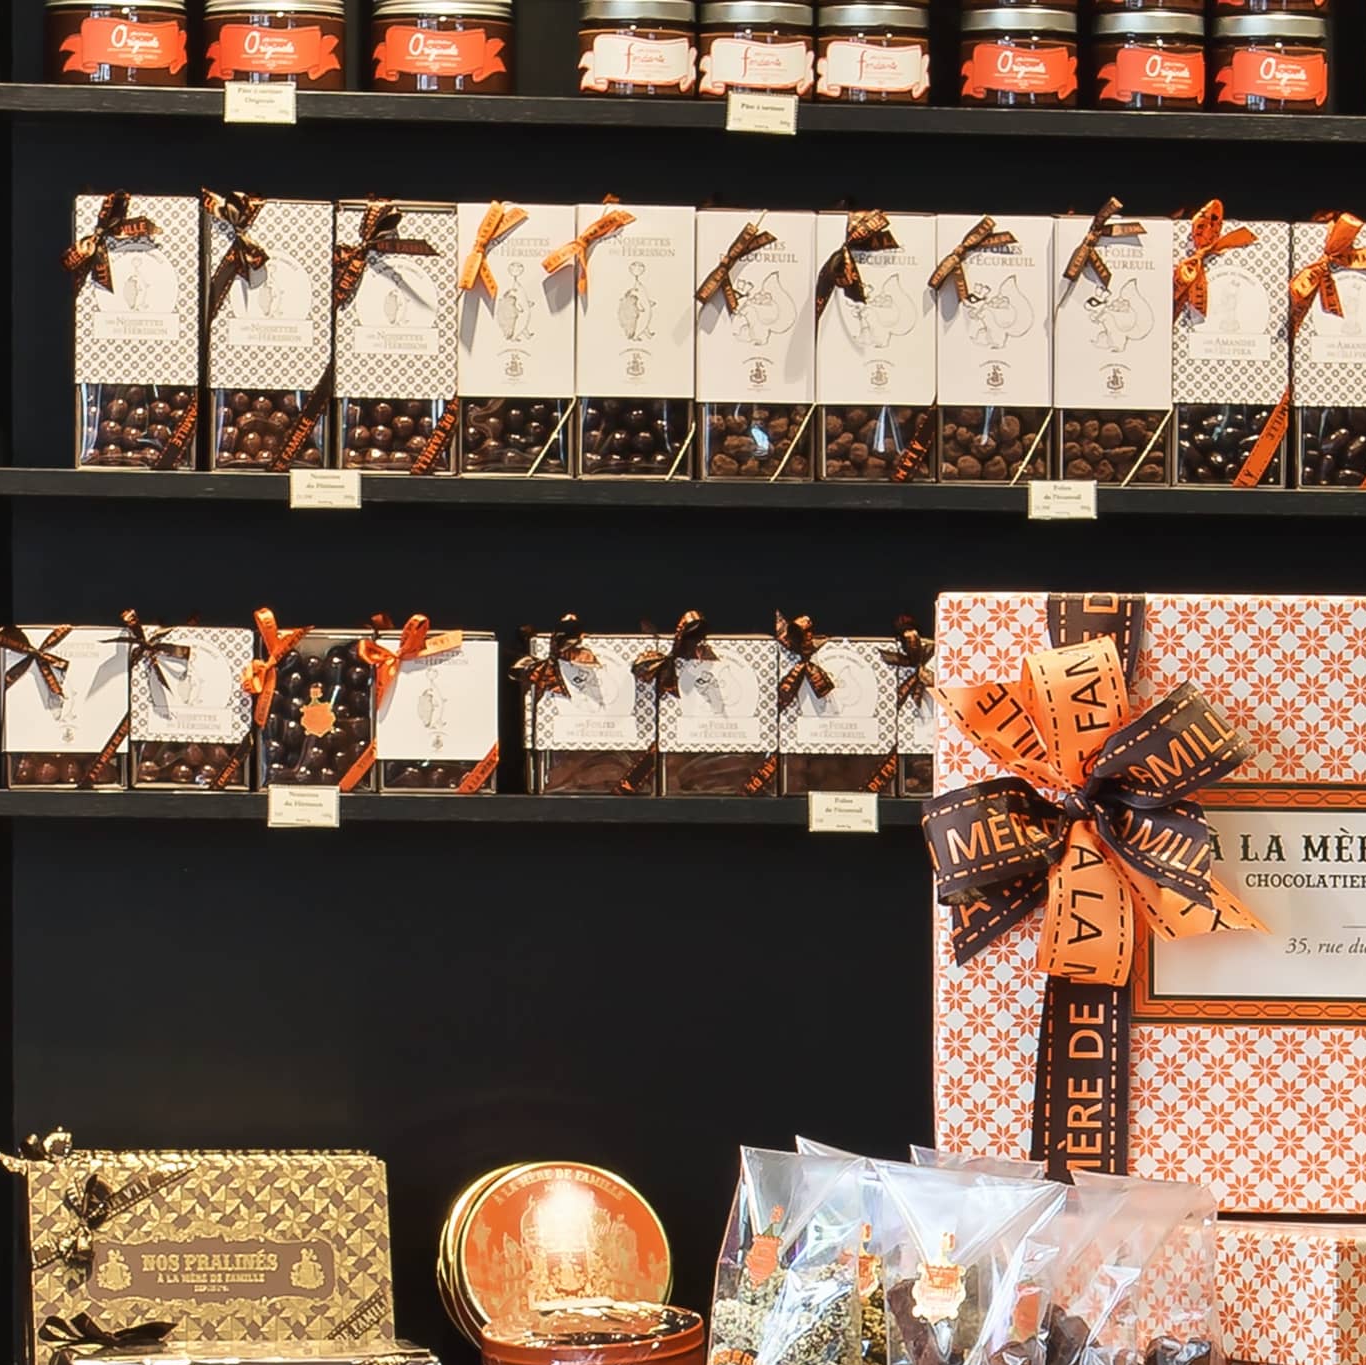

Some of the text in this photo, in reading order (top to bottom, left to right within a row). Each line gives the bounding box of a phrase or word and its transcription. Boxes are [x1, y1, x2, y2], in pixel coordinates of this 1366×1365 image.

[1239, 833, 1285, 862] LA
[1285, 938, 1312, 957] 35,
[1317, 943, 1344, 955] rue
[1068, 1003, 1105, 1060] DE
[555, 1167, 572, 1180] DE
[575, 1169, 626, 1201] FAMILLE
[141, 1248, 279, 1272] NOS PRALINÉS
[166, 1273, 180, 1284] LA
[209, 1273, 223, 1284] DE
[225, 1273, 266, 1284] FAMILLE
